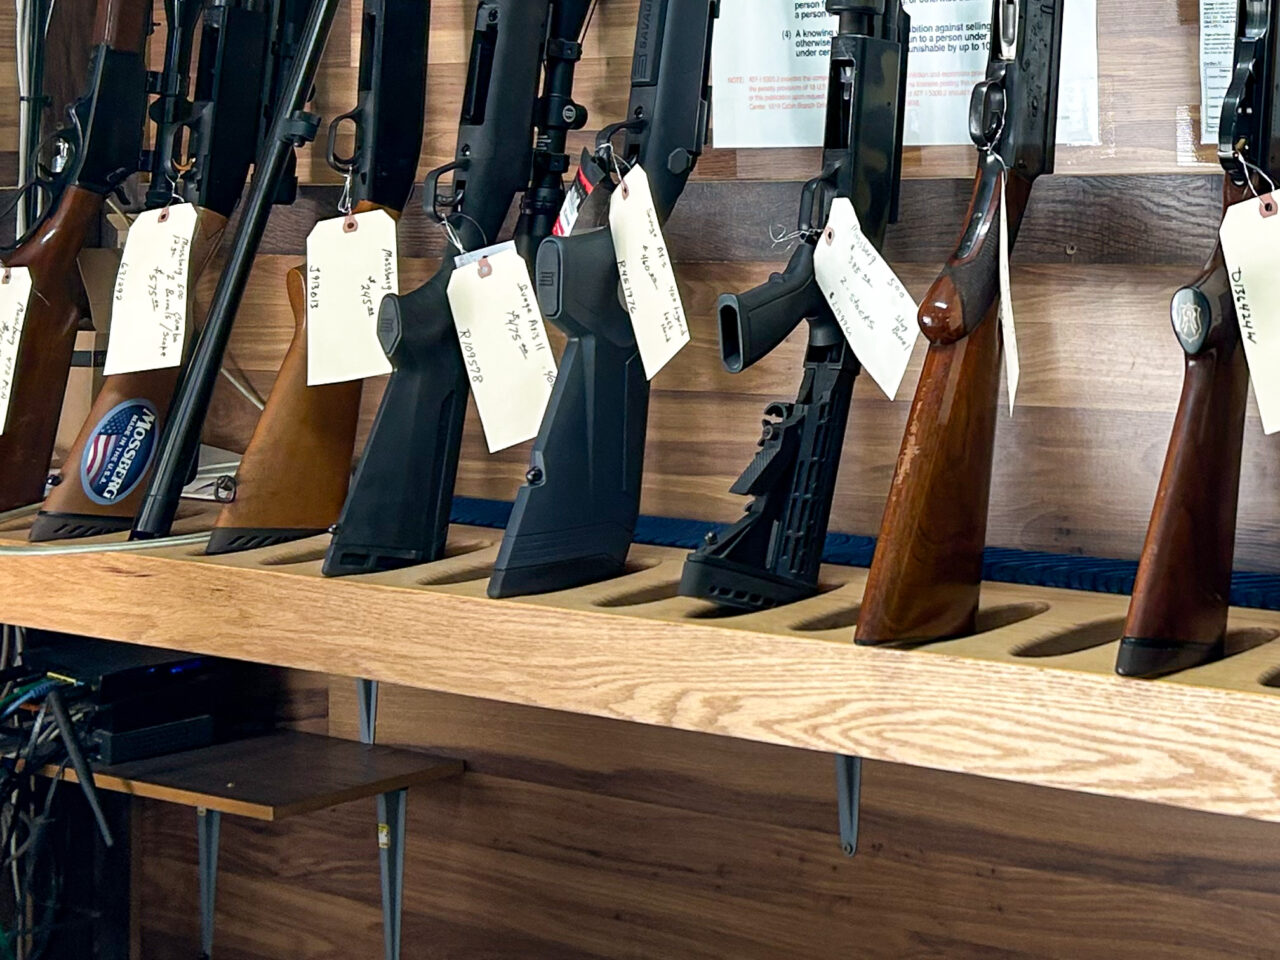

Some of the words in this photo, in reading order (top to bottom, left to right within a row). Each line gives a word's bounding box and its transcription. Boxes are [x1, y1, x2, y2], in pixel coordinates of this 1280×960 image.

[794, 1, 819, 10] person
[801, 10, 826, 19] person
[803, 29, 833, 37] knowing
[935, 23, 963, 33] against
[936, 34, 962, 43] person
[964, 31, 988, 40] under
[796, 49, 816, 57] under
[947, 43, 957, 53] by
[959, 43, 970, 52] up
[971, 42, 979, 50] to
[124, 415, 138, 436] MADE
[119, 437, 127, 445] IN
[103, 407, 155, 500] MOSSBERG
[111, 448, 122, 462] THE
